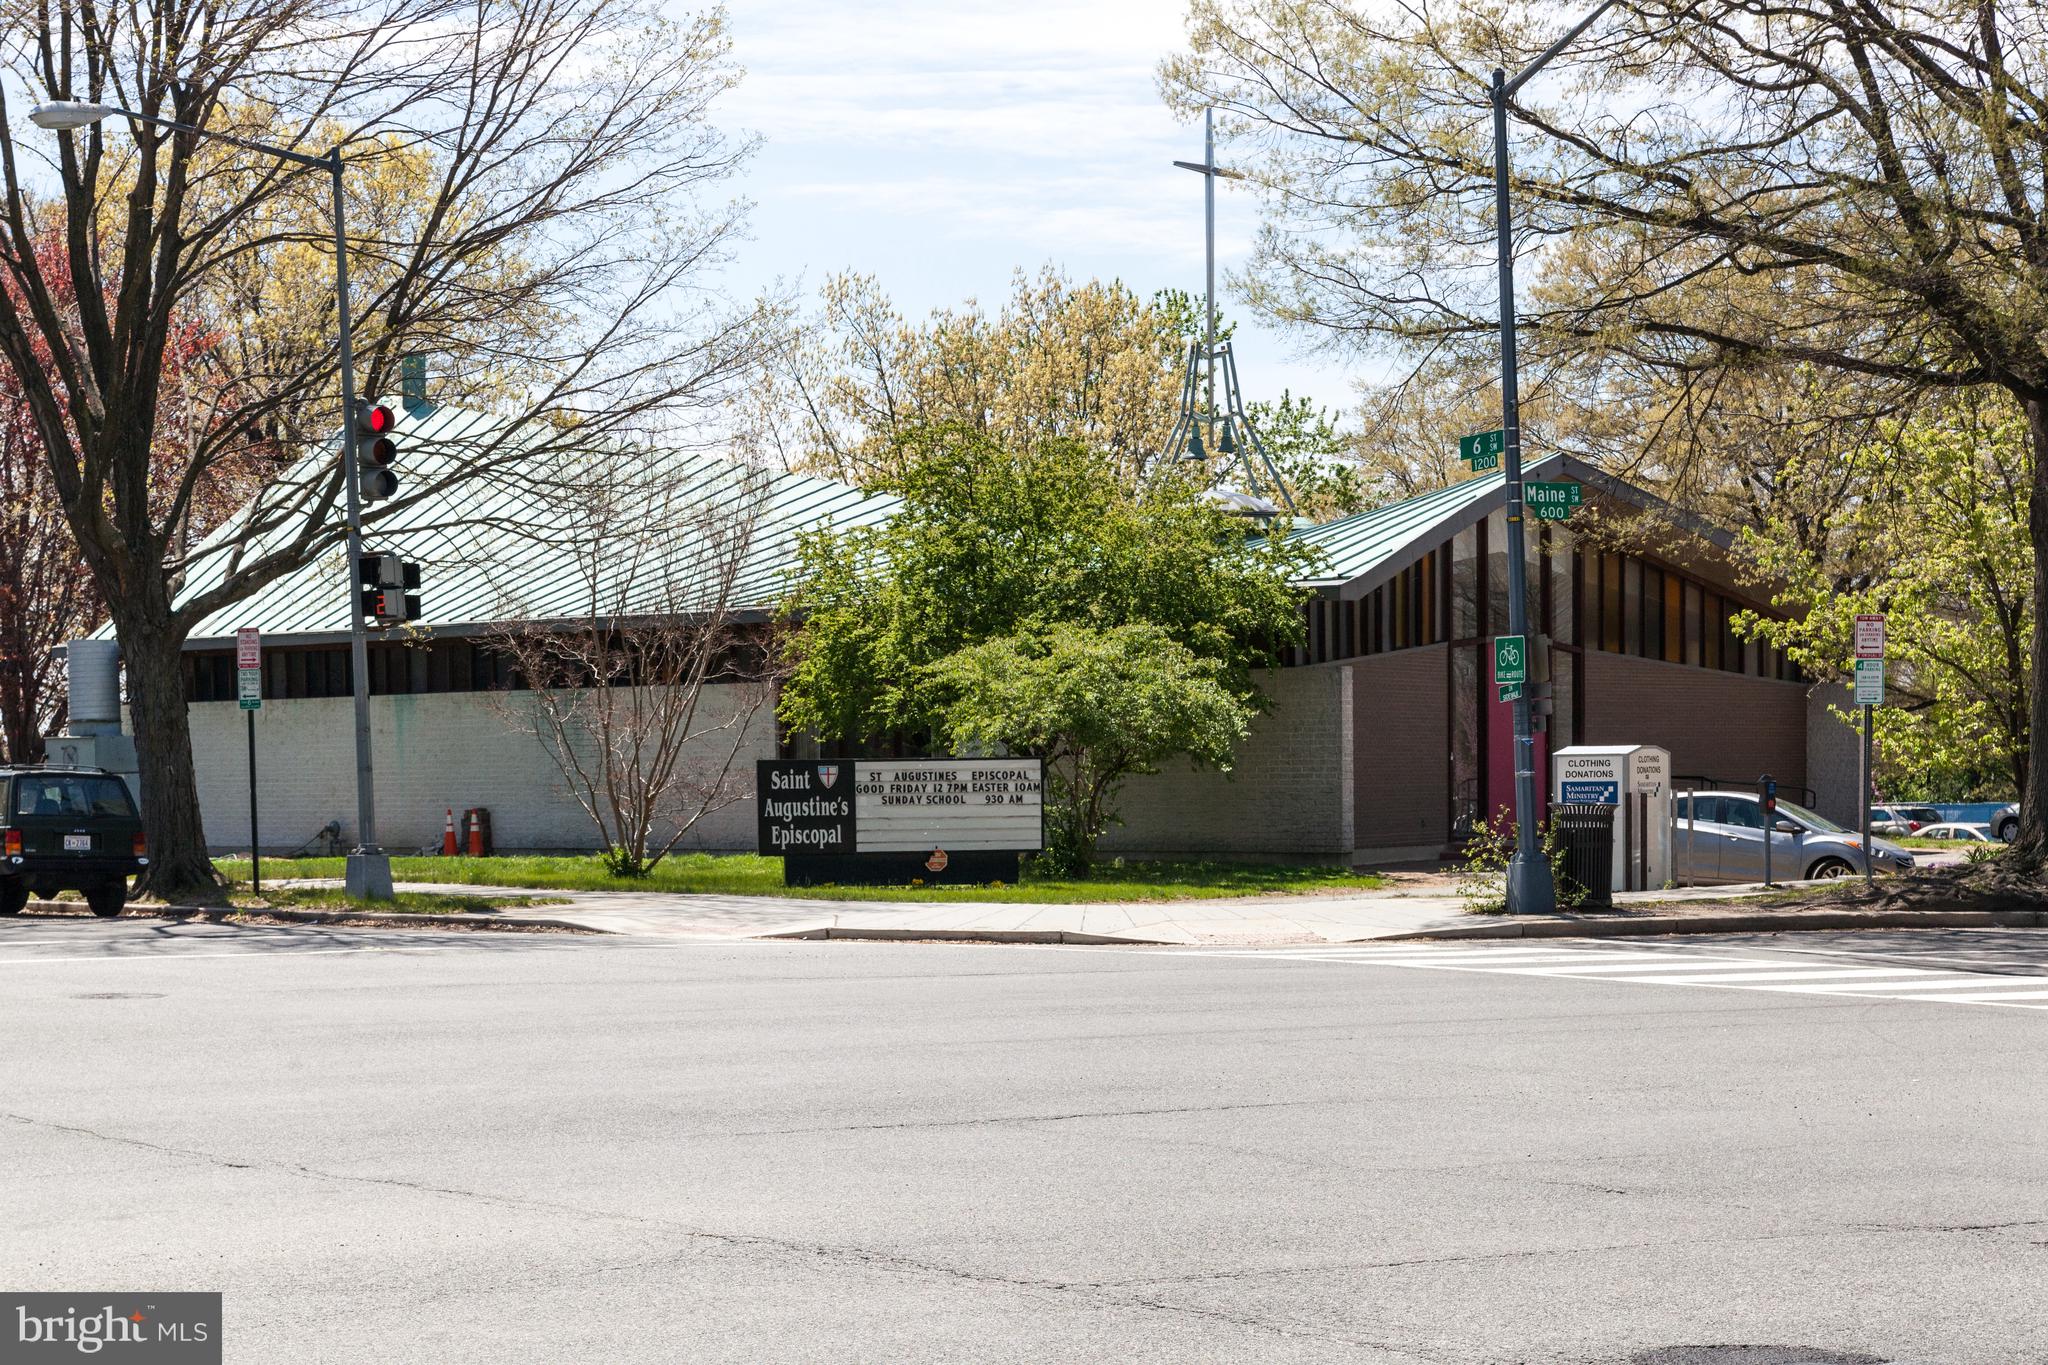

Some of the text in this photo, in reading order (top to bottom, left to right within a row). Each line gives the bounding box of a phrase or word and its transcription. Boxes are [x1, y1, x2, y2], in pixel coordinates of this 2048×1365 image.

[1473, 434, 1498, 455] 6 ST SW
[1474, 456, 1496, 471] 1200
[1527, 486, 1579, 503] Maine ST SW
[1540, 506, 1564, 519] 600
[1497, 670, 1524, 679] BIKE ROUTE
[1568, 759, 1611, 767] CLOTHING
[1638, 755, 1660, 763] CLOTHING
[870, 770, 1029, 782] ST AUGUSTINES EPISCOPAL
[1565, 770, 1614, 778] DONATIONS
[1637, 766, 1661, 774] DONATIONS
[771, 768, 811, 790] Saint
[856, 784, 885, 794] GOOD
[890, 784, 928, 793] FRIDAY
[933, 783, 943, 793] 12
[972, 783, 1009, 792] EASTER
[1014, 782, 1041, 792] 10AM
[881, 794, 1024, 805] SUNDAY SCHOOL 930 AM
[764, 795, 849, 822] Augustine's
[771, 823, 842, 850] Episcopal
